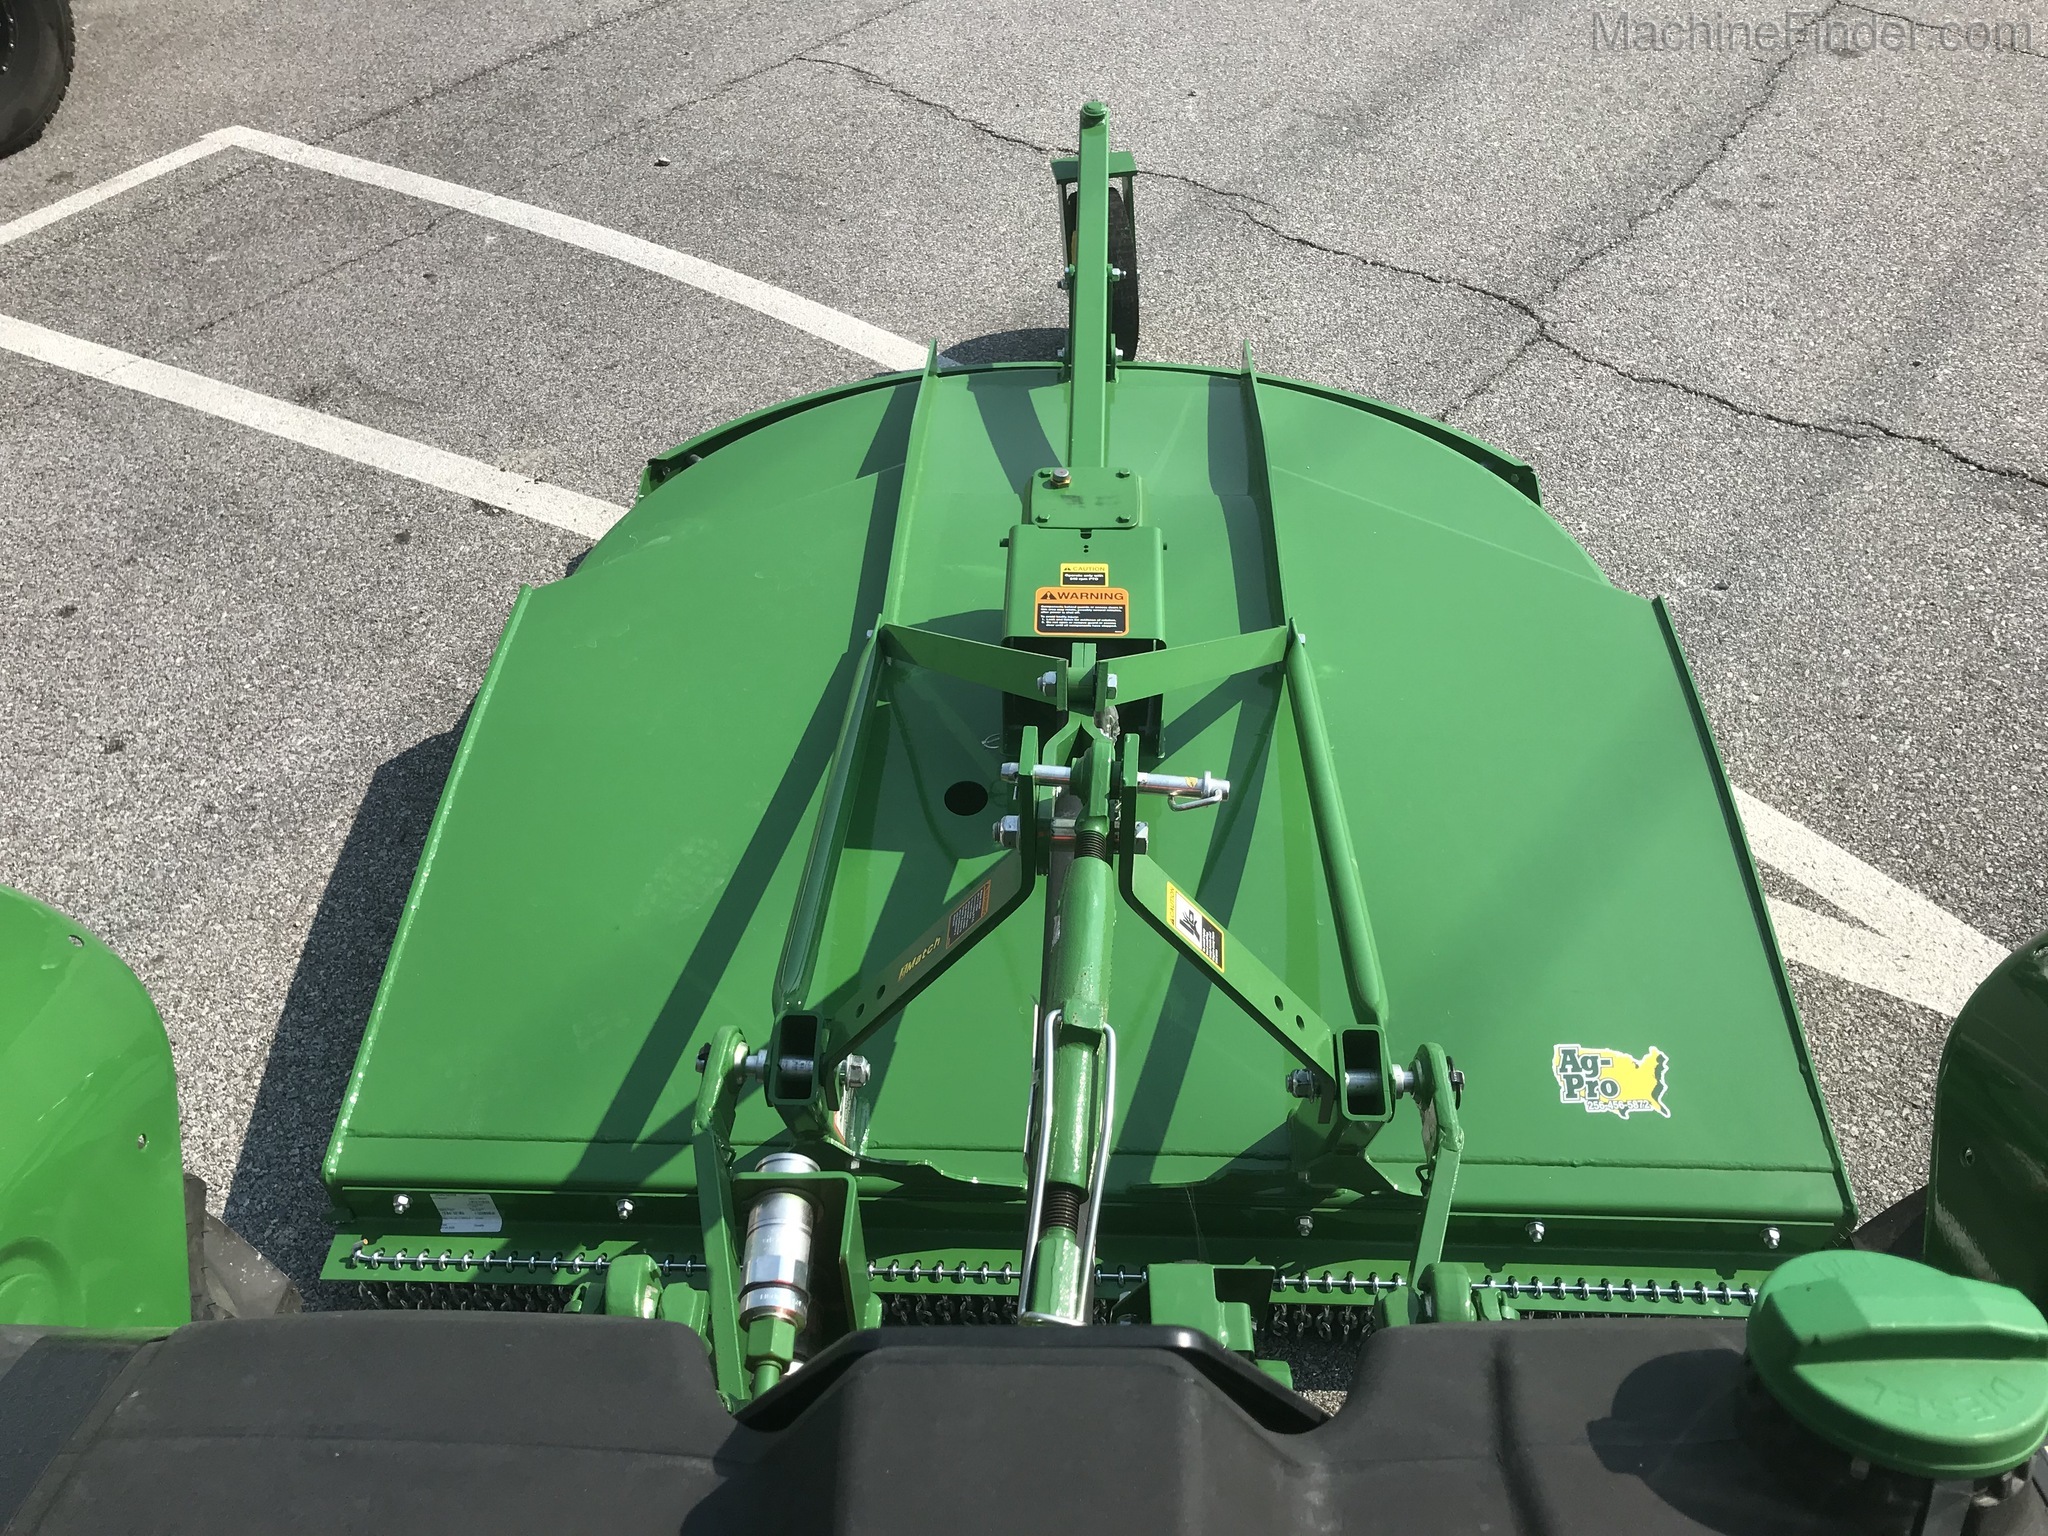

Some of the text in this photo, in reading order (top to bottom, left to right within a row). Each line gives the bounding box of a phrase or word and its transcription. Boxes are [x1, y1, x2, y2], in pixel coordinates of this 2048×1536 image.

[1057, 591, 1124, 601] WARNING
[1559, 1048, 1611, 1078] Ag-
[1562, 1074, 1619, 1099] Pro
